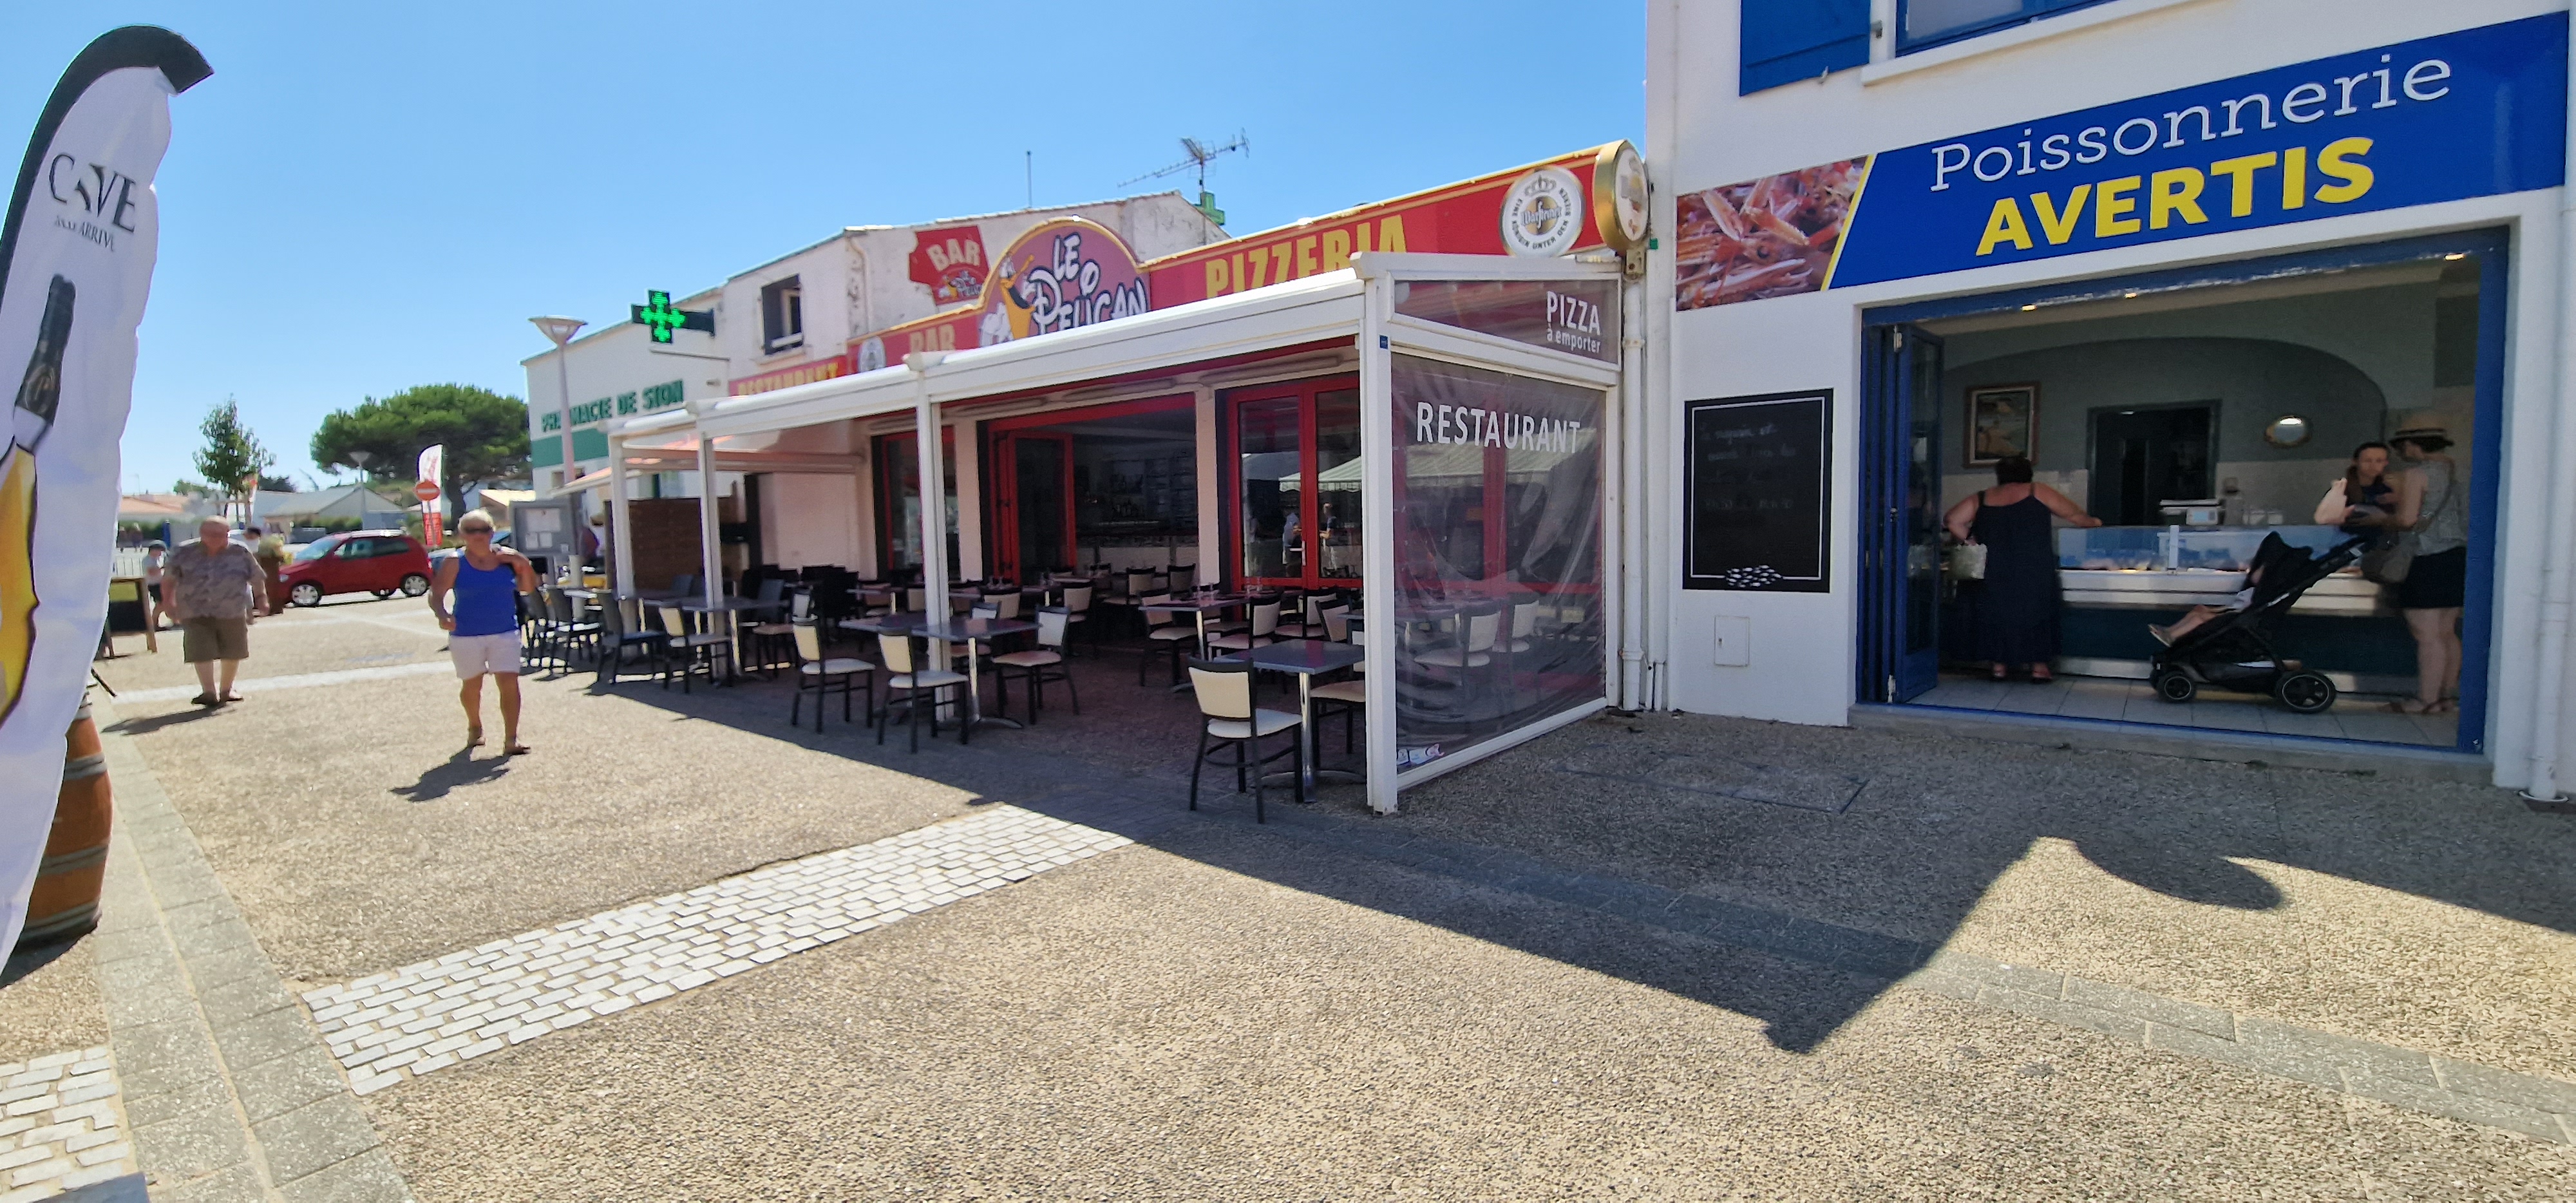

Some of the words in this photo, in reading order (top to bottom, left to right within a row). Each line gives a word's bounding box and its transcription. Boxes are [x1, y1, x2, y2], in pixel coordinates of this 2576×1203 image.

[1930, 54, 2451, 192] Poissonnerie
[49, 153, 136, 233] CAVE
[1975, 137, 2375, 256] AVERTIS
[926, 238, 980, 272] BAR
[1053, 232, 1081, 282] LE
[1205, 214, 1406, 298] PIZZERIA
[1547, 290, 1600, 336] PIZZA
[1556, 330, 1601, 354] emporter
[541, 397, 613, 432] PHAMACIE
[617, 391, 638, 415] DE
[642, 379, 684, 409] SION
[1417, 401, 1580, 453] RESTAURANT
